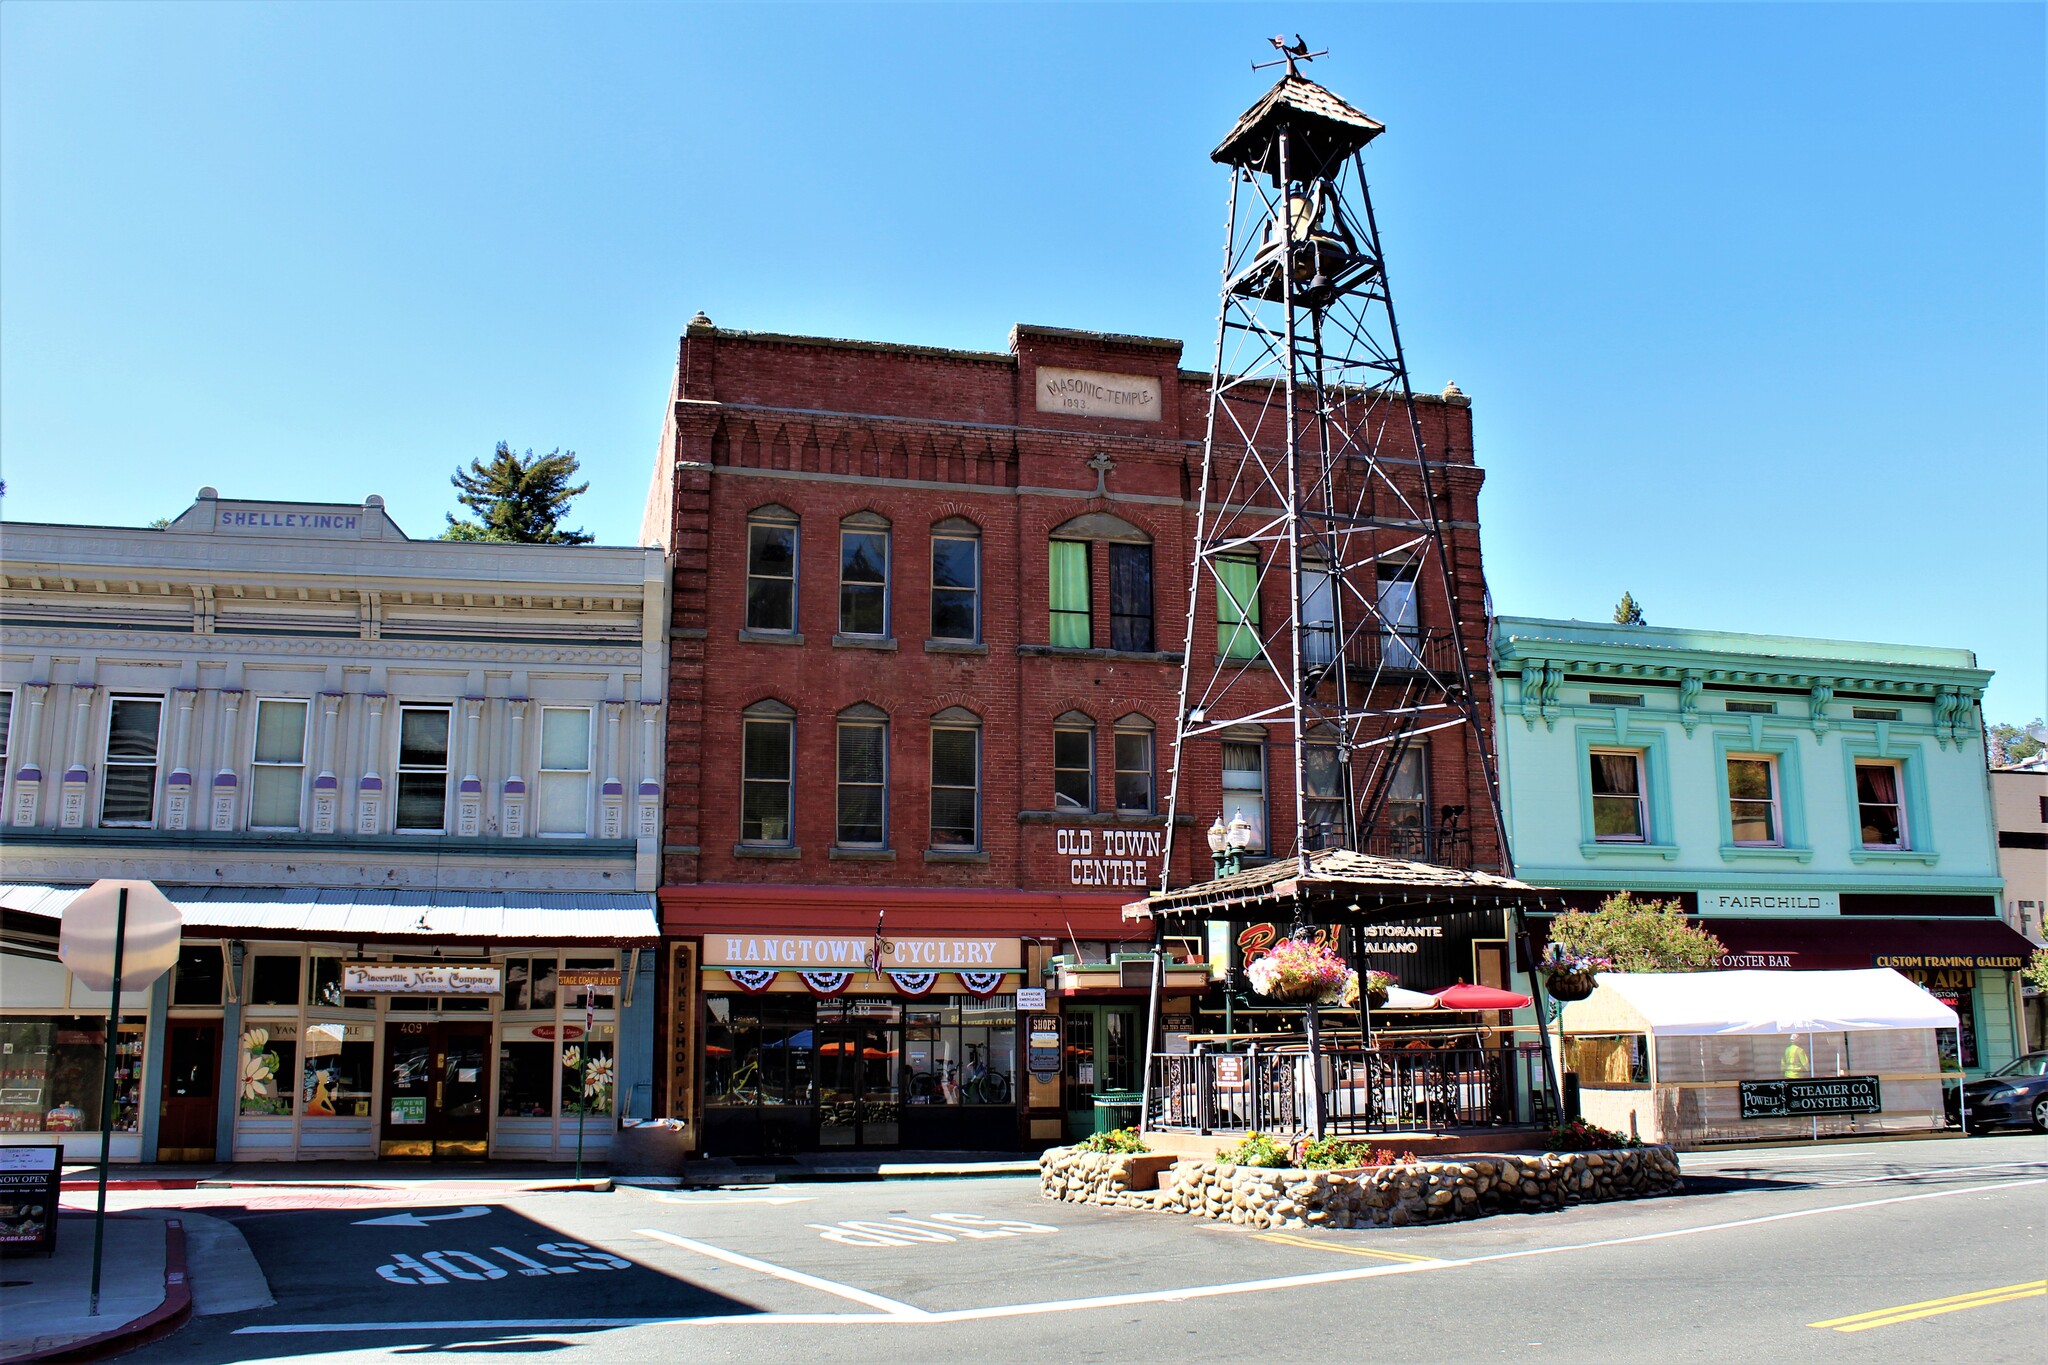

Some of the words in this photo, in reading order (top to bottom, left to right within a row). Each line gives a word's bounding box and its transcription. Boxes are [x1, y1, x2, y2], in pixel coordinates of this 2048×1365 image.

[1046, 378, 1103, 400] MASONIC
[1056, 828, 1093, 855] OLD
[1102, 829, 1161, 857] TOWN
[1071, 858, 1147, 886] CENTRE
[1719, 896, 1821, 909] FAIRCHILD
[726, 938, 866, 962] HANGTOWN
[894, 940, 996, 964] CYCLERY
[1352, 940, 1418, 954] IALIANO
[1721, 954, 1767, 968] OYSTER
[1768, 955, 1792, 968] BAR
[1876, 956, 1923, 967] CUSTOM
[1925, 956, 1973, 968] FRAMING
[1976, 956, 2022, 968] GALLERY
[348, 969, 408, 984] Placerville
[404, 970, 444, 989] News
[449, 971, 495, 989] Company
[559, 976, 577, 985] STAGE
[578, 976, 599, 985] COACH
[600, 976, 619, 985] ALLEY
[677, 956, 687, 1012] BIKE
[1934, 969, 1974, 988] ART
[400, 1022, 422, 1034] 409
[1033, 1019, 1057, 1030] SHOPS
[675, 1022, 685, 1077] SHOP
[1791, 1084, 1849, 1097] STEAMER
[1851, 1083, 1872, 1095] CO.
[675, 1086, 685, 1119] IK
[1801, 1096, 1849, 1109] OYSTER
[1851, 1095, 1875, 1107] BAR
[21, 1175, 48, 1183] OPEN
[804, 1212, 1060, 1247] STOP
[375, 1242, 633, 1285] STOP
